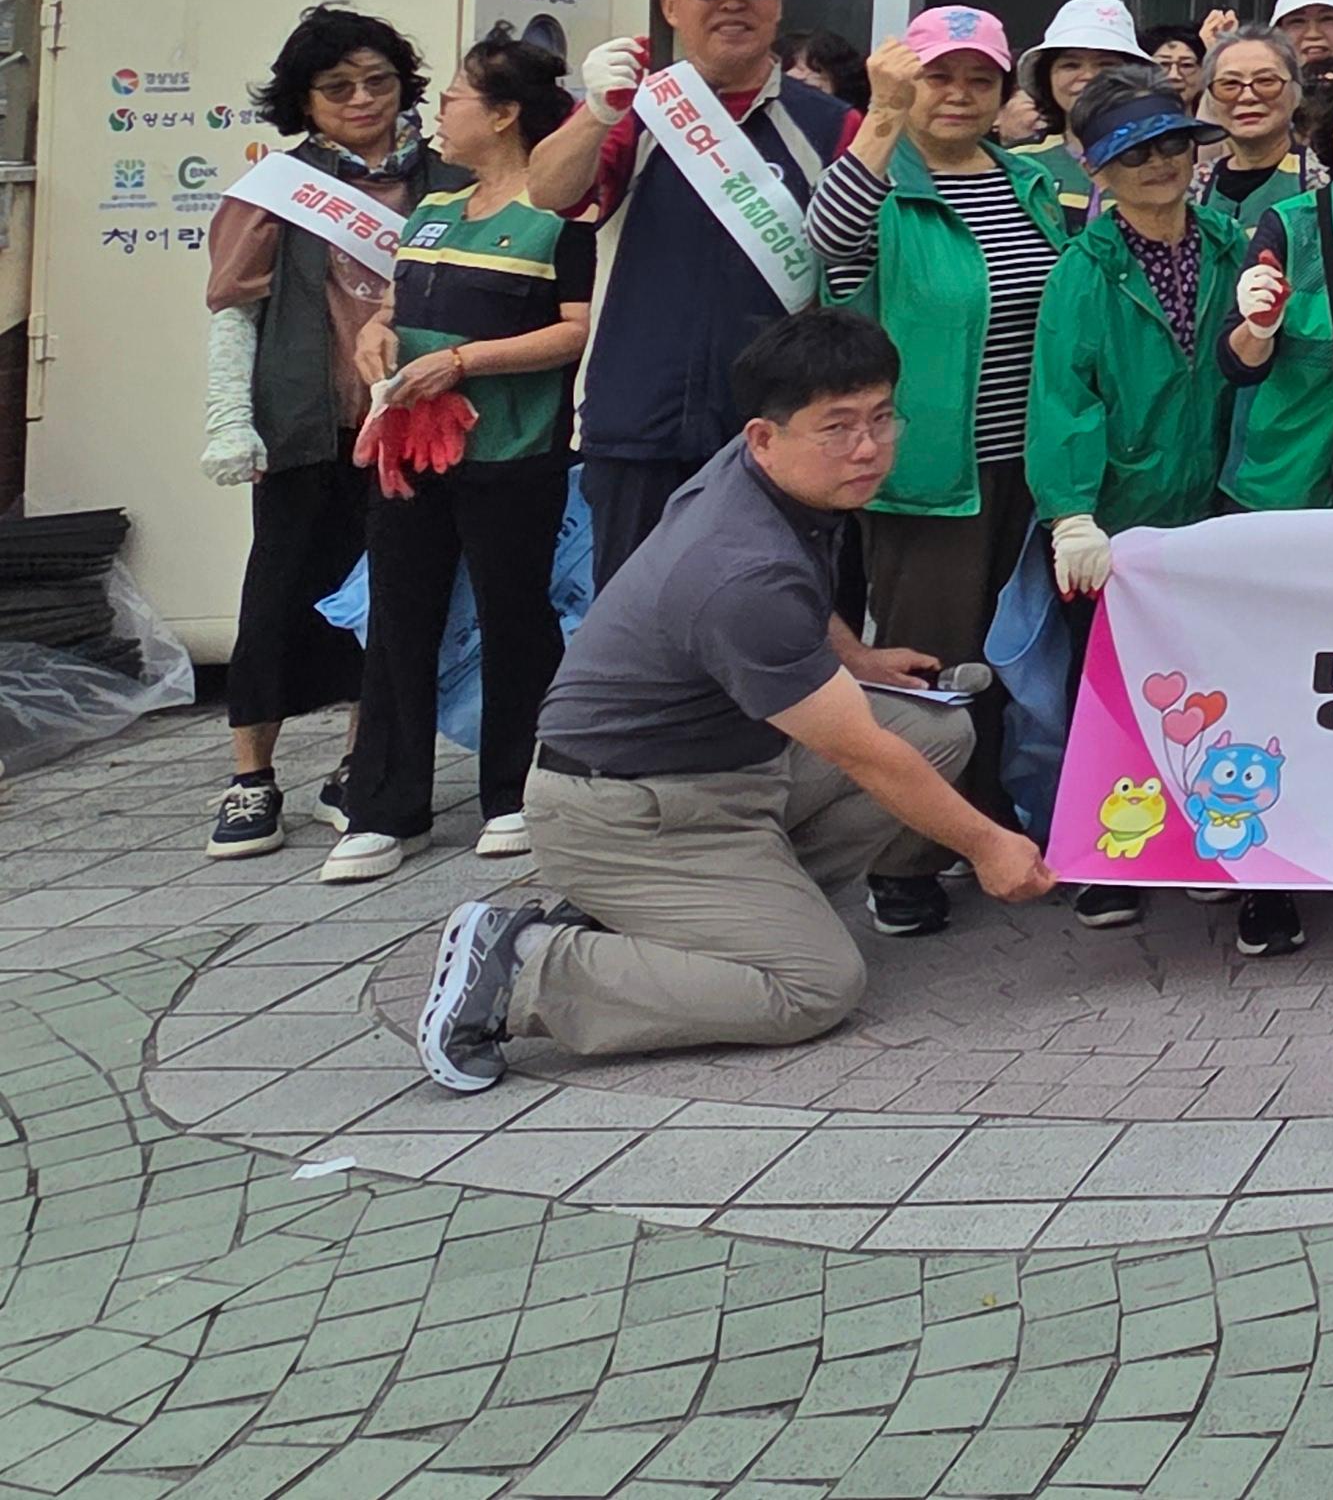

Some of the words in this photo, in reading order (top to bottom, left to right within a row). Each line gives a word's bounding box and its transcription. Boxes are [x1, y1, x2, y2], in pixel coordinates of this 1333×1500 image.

[142, 112, 195, 127] 양산시
[646, 72, 730, 174] 께해요!
[720, 171, 811, 281] 청렴양산
